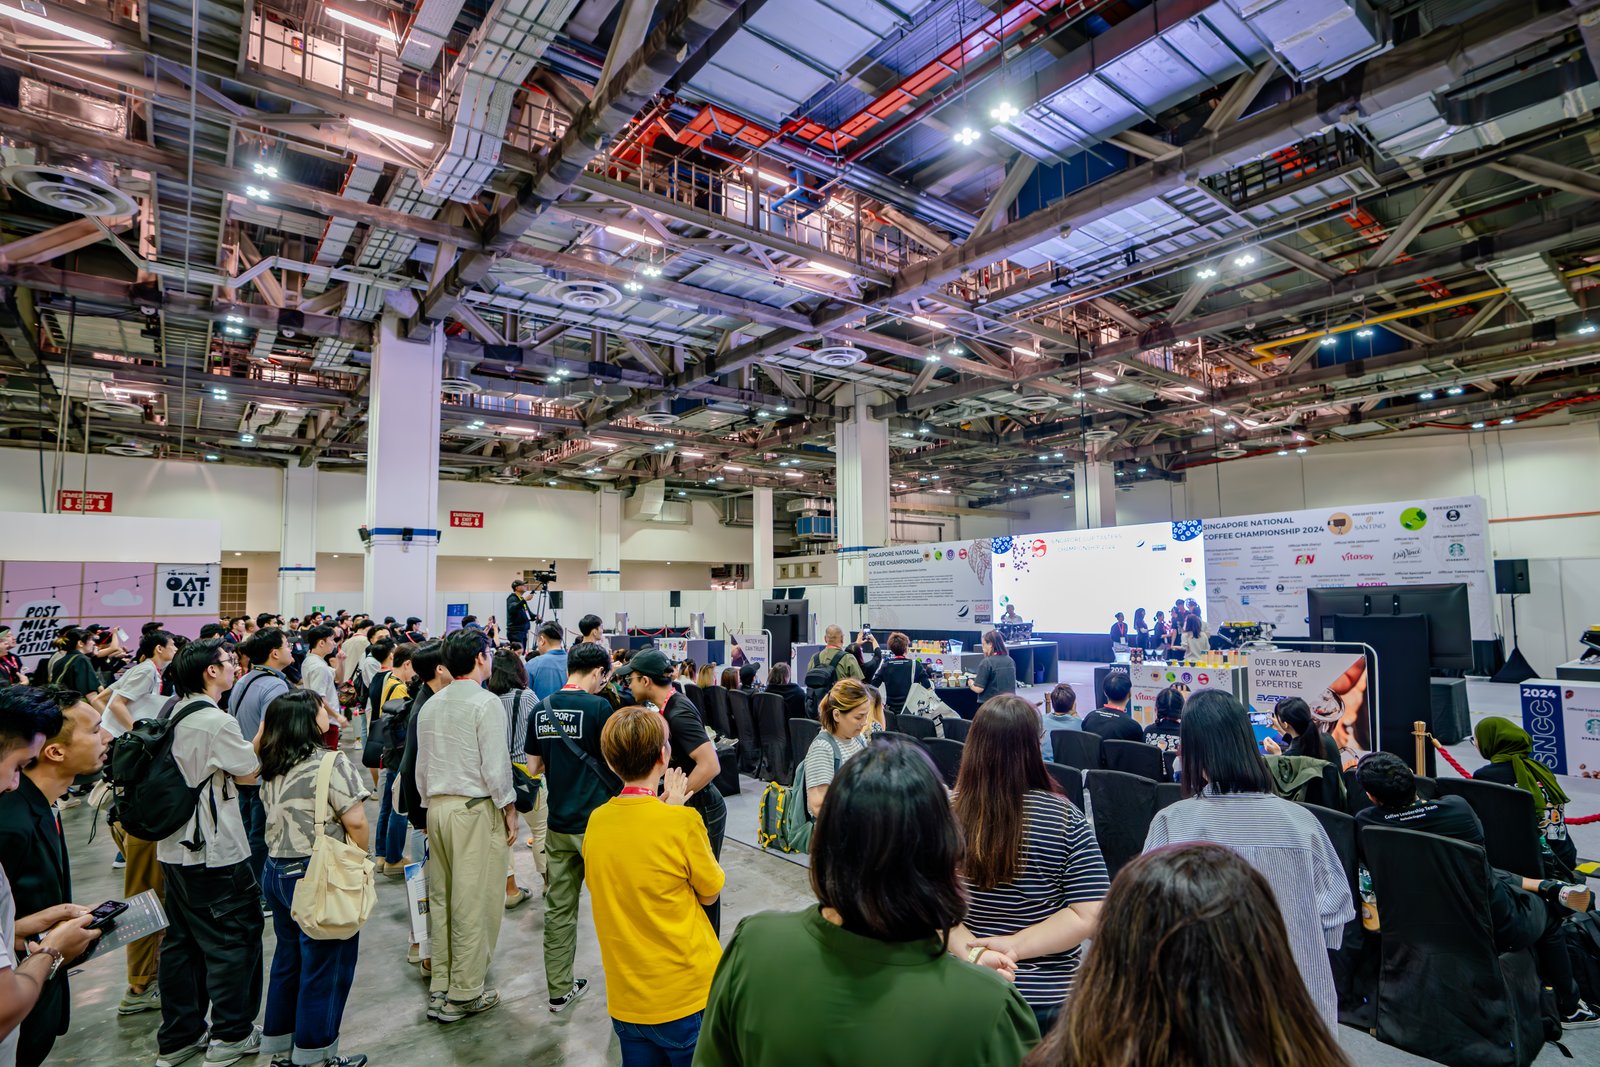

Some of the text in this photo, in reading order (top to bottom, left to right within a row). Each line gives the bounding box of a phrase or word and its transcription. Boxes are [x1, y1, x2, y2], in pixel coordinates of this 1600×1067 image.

[1203, 517, 1294, 530] SINGAPORE NATIONAL
[1203, 526, 1325, 541] COFFEE CHAMPIONSHIP 2024
[868, 549, 920, 559] SINGAPORE NATIONAL
[1341, 552, 1374, 561] Vitasoy
[886, 557, 923, 566] CHAMPIONSHIP
[172, 592, 205, 607] LY!
[26, 605, 61, 618] POST
[19, 619, 60, 632] MILK
[1255, 658, 1277, 666] OVER
[1291, 660, 1321, 668] YEARS
[1255, 669, 1298, 678] OF WATER
[1255, 680, 1303, 689] EXPERTISE
[1135, 693, 1156, 701] Vitaso
[1522, 688, 1557, 699] 2024
[540, 712, 575, 723] SUPORT
[538, 724, 577, 733] FISHEMAN
[1529, 699, 1558, 769] SNCC
